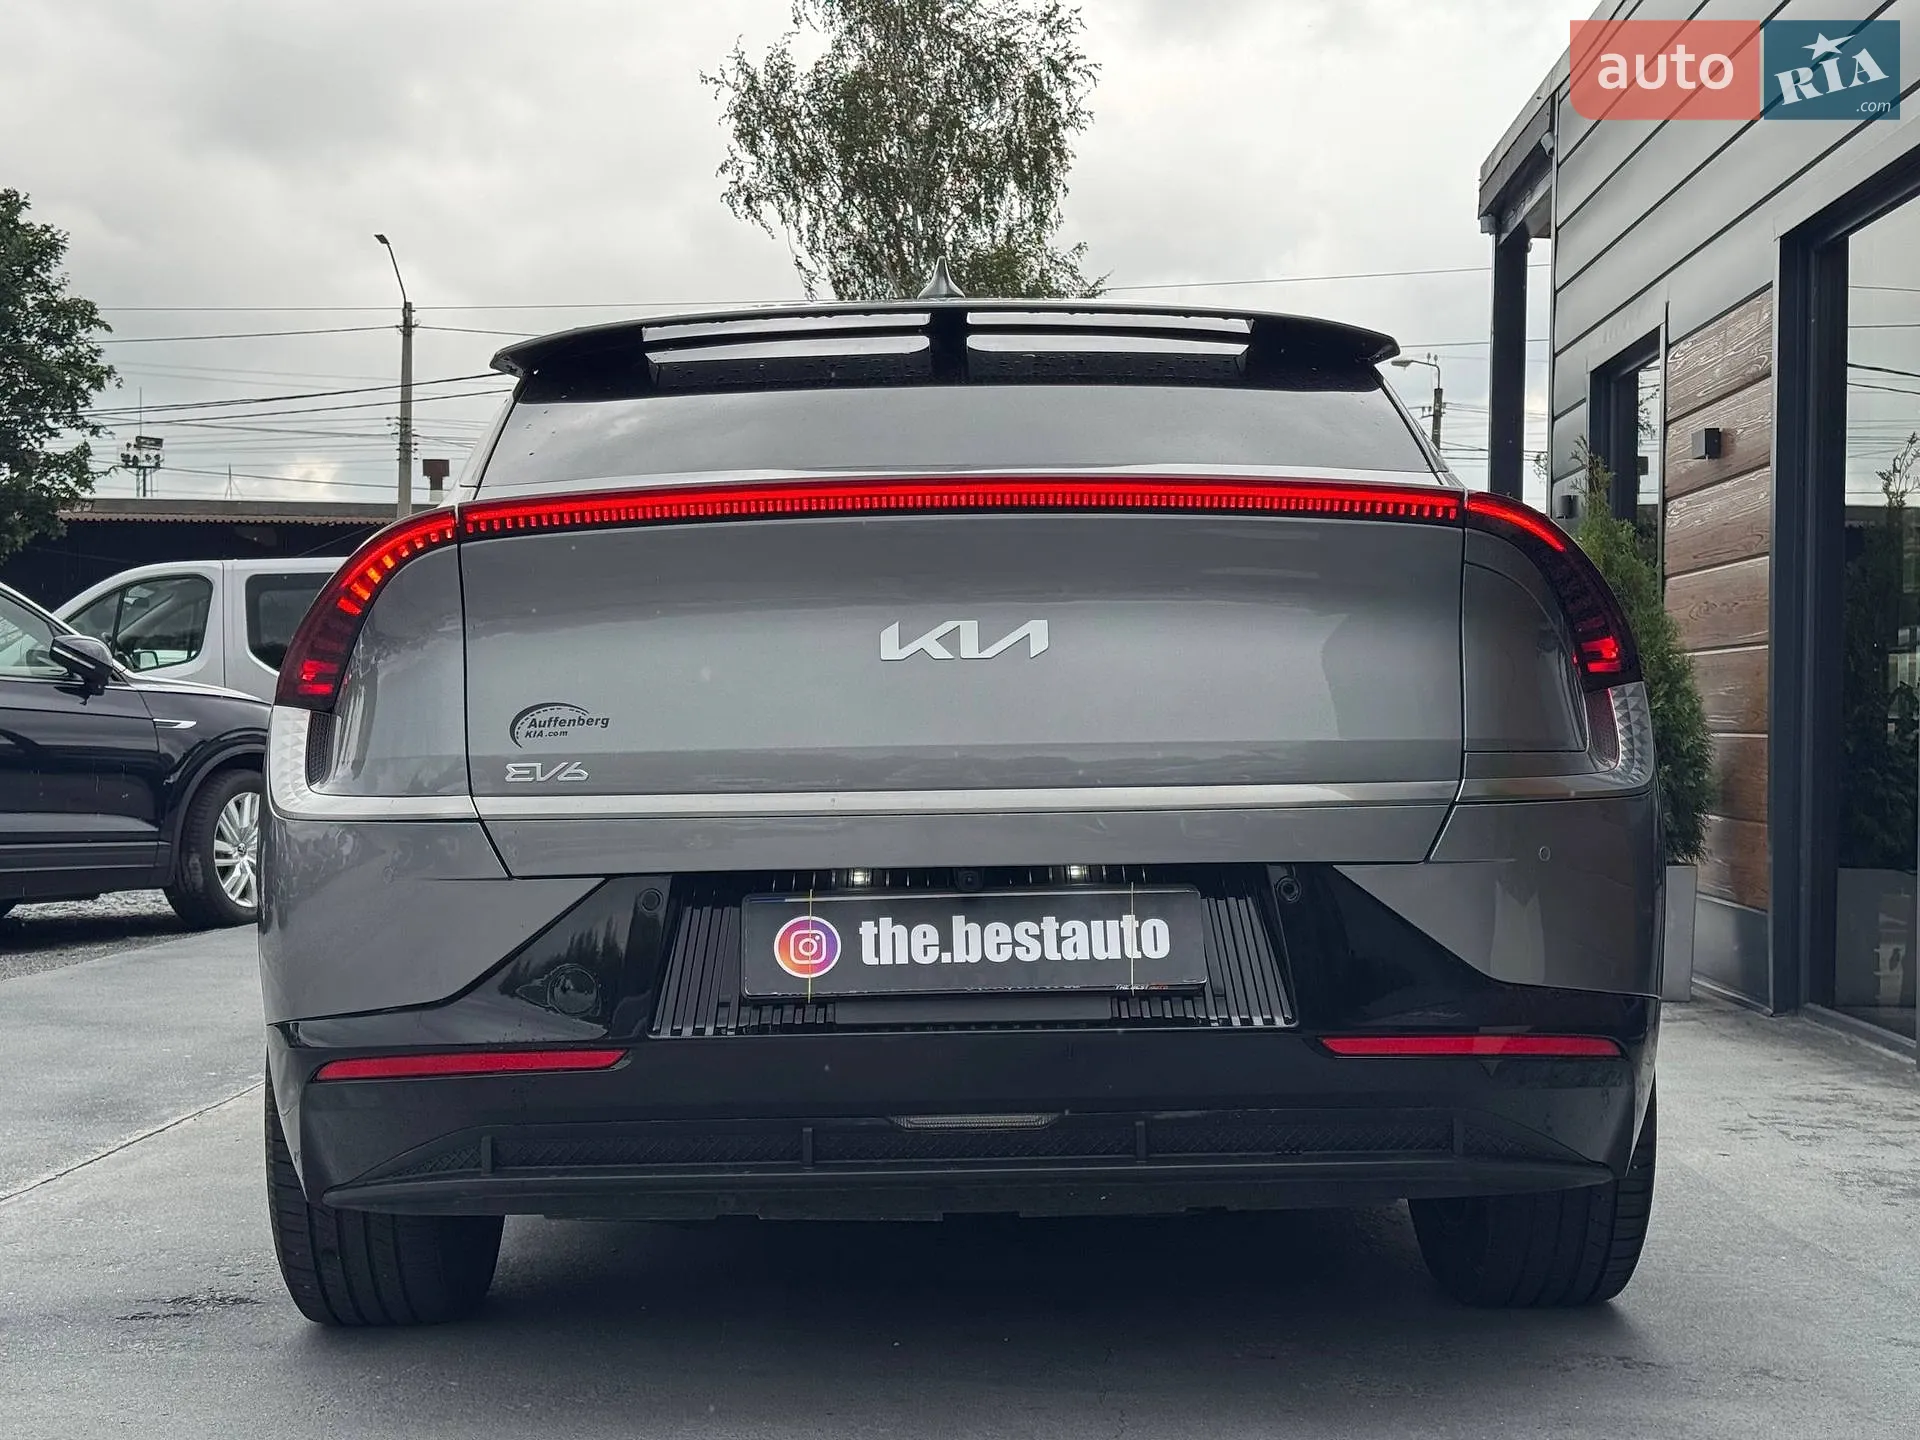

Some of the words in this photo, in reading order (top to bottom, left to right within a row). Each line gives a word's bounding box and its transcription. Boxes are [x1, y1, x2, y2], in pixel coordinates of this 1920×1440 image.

[880, 619, 1048, 661] KIA
[527, 716, 610, 728] Auffenberg
[505, 761, 589, 782] EV6
[859, 914, 1170, 965] the.bestauto
